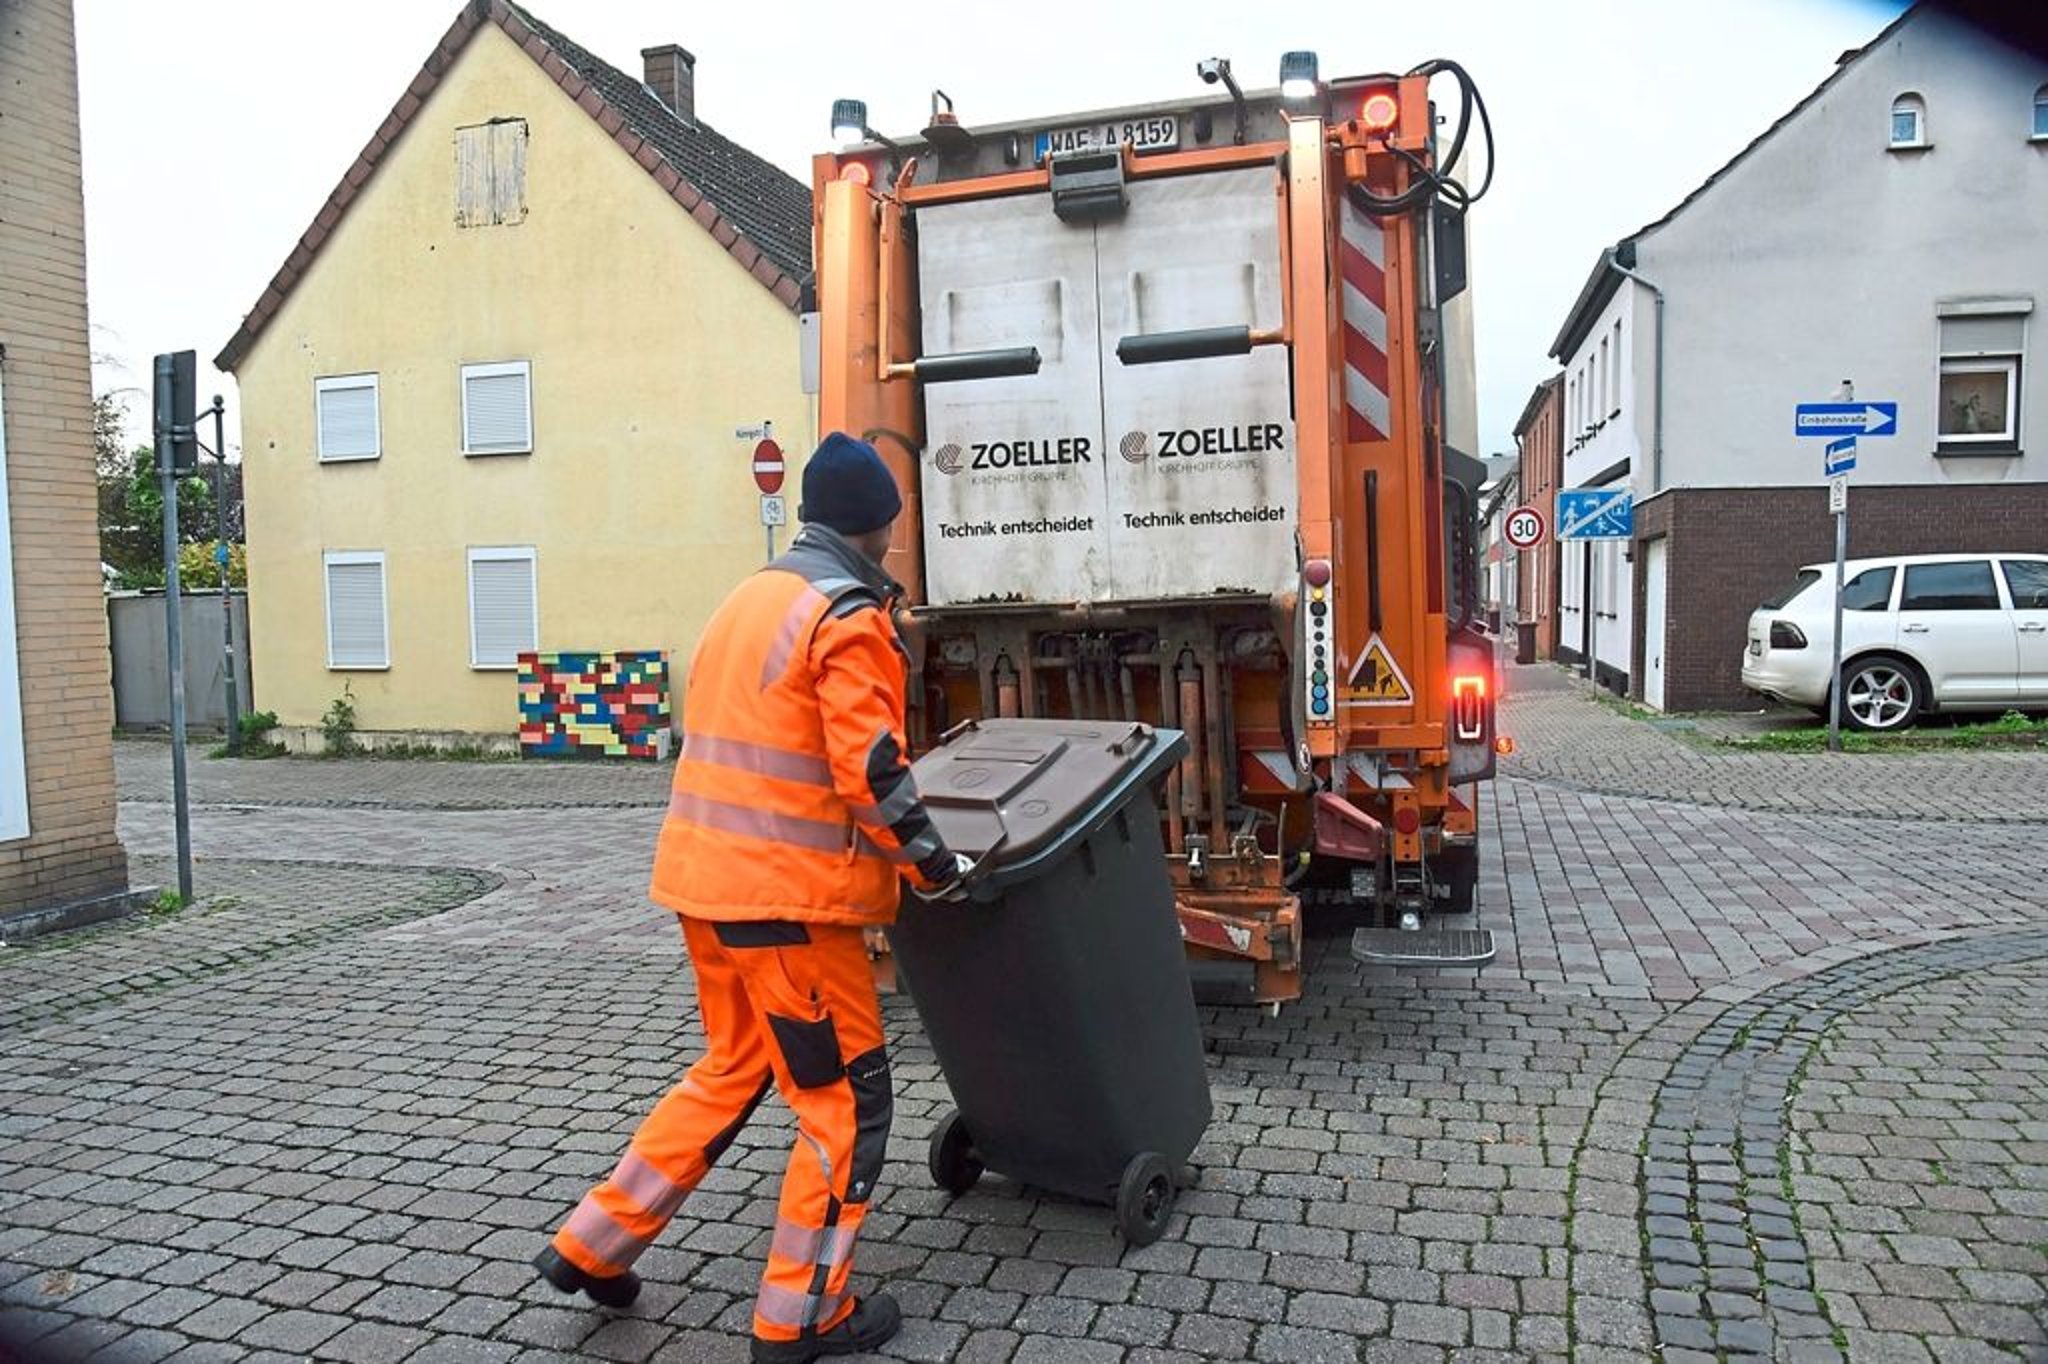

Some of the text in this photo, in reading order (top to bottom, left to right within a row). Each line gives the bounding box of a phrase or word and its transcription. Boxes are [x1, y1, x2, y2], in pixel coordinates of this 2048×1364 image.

[1105, 126, 1117, 145] A
[1123, 119, 1173, 145] 8159
[1157, 423, 1284, 458] ZOELLER
[971, 437, 1091, 470] ZOELLER
[938, 515, 1094, 538] Technik entscheidet
[1123, 506, 1286, 529] Technik entscheidet
[1513, 519, 1536, 537] 30
